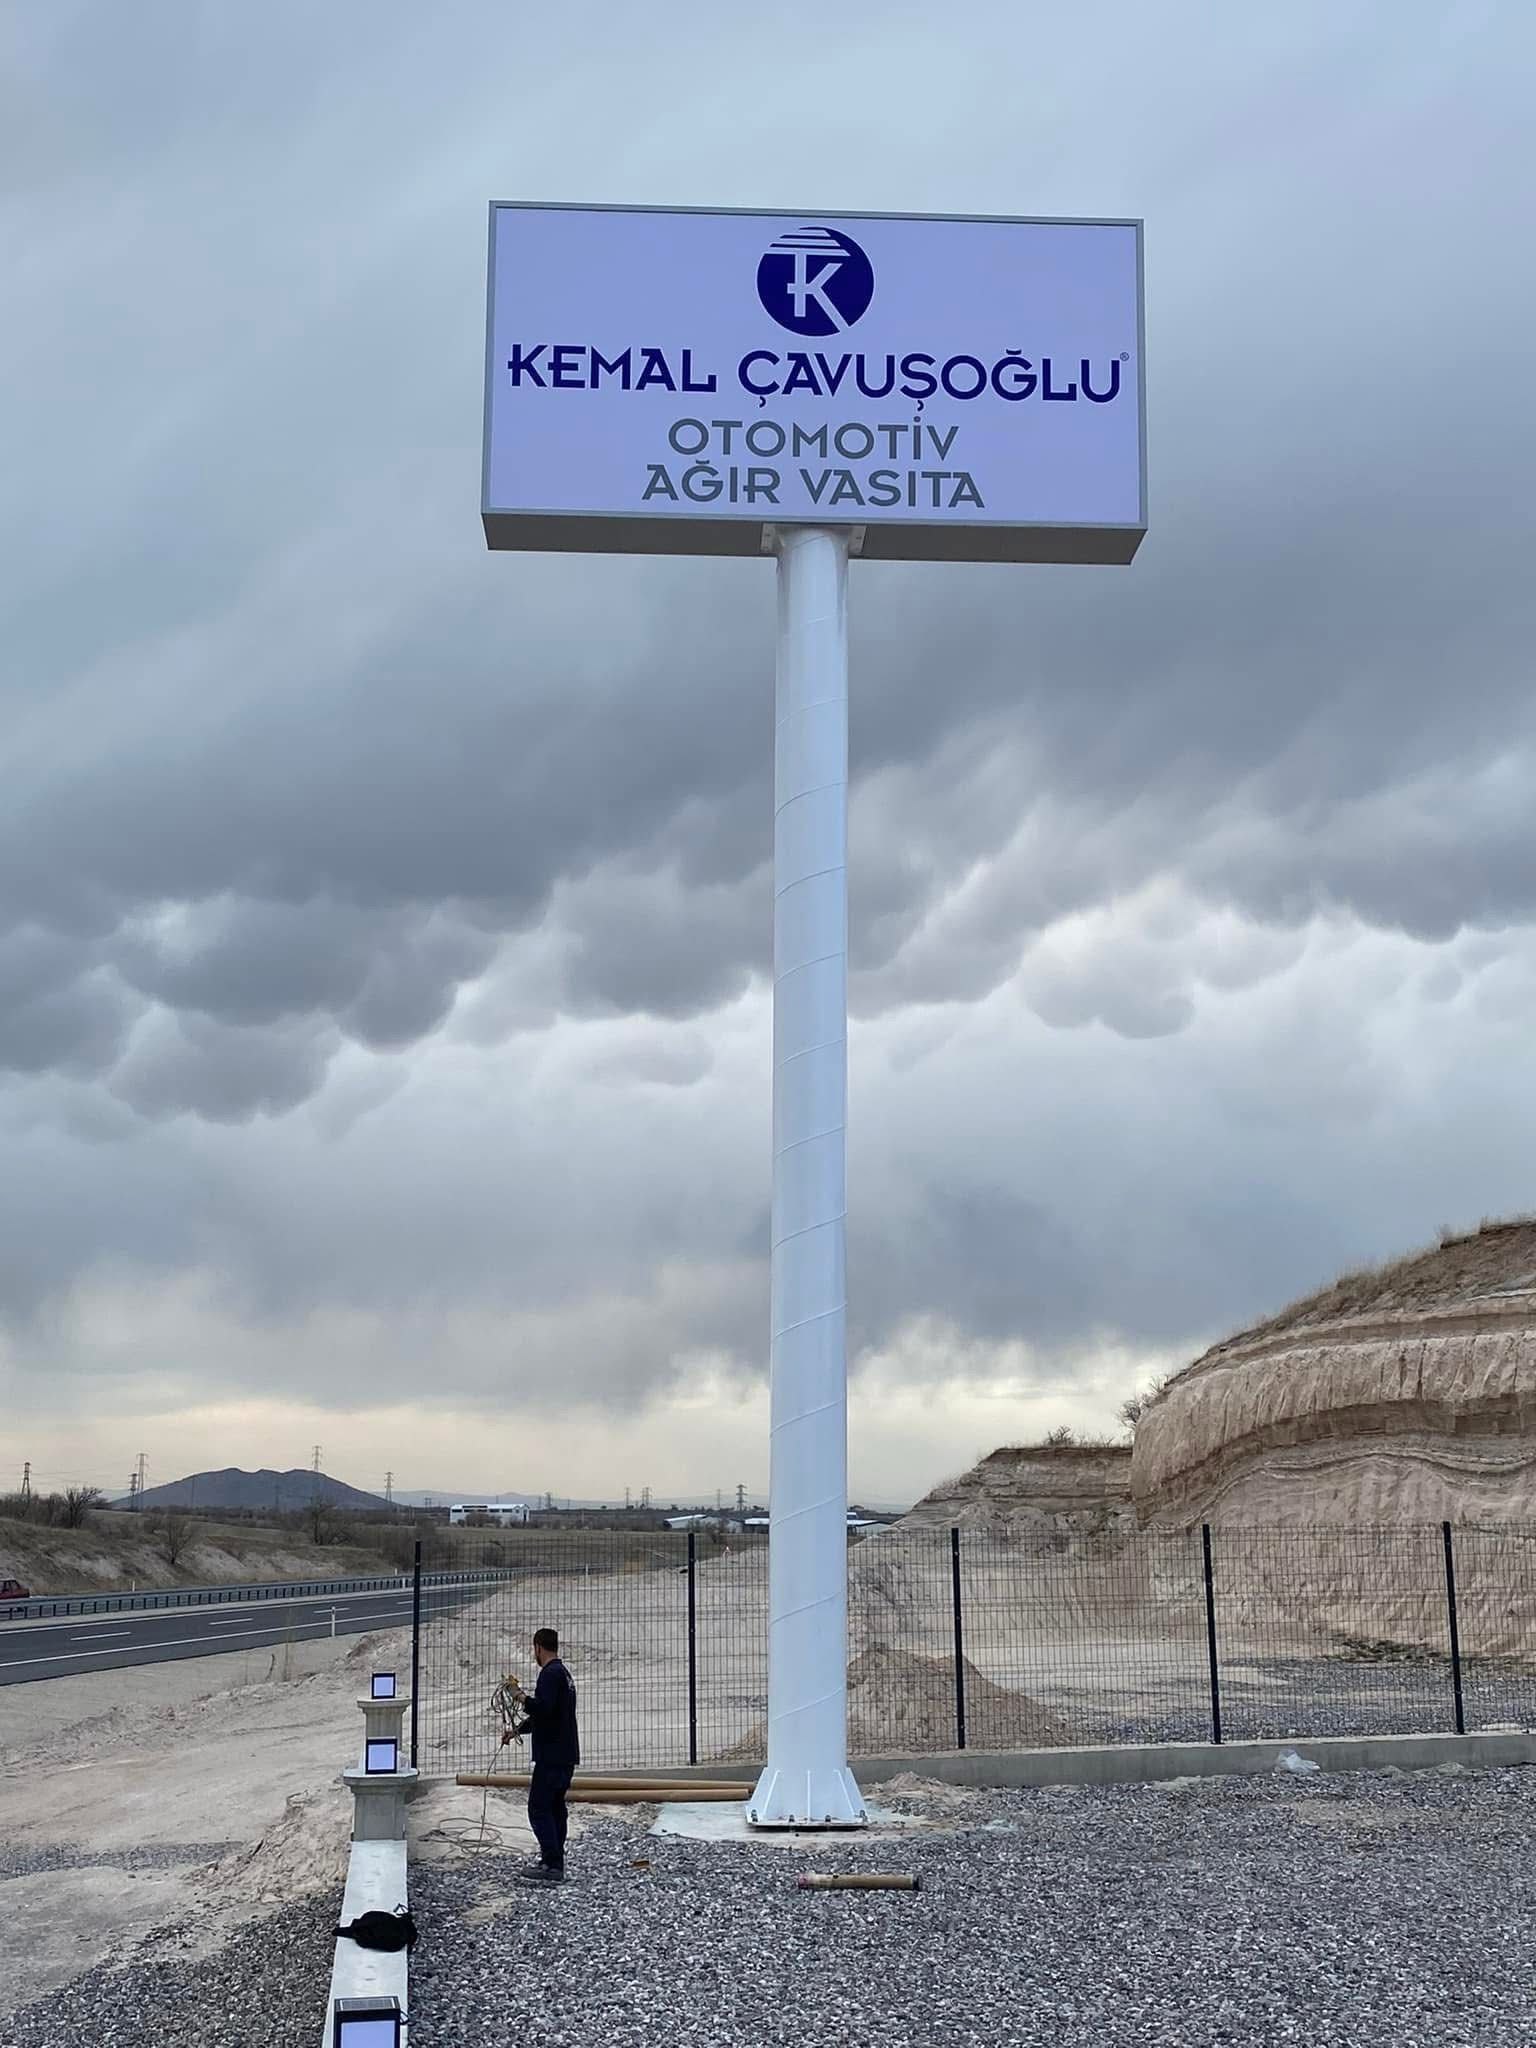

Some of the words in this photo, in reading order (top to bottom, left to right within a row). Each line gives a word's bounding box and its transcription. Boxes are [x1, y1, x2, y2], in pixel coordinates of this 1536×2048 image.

[508, 344, 718, 393] KEMAL
[668, 416, 960, 461] OTOMOTİV
[641, 459, 780, 504] AĞIR
[799, 468, 986, 509] VASITA
